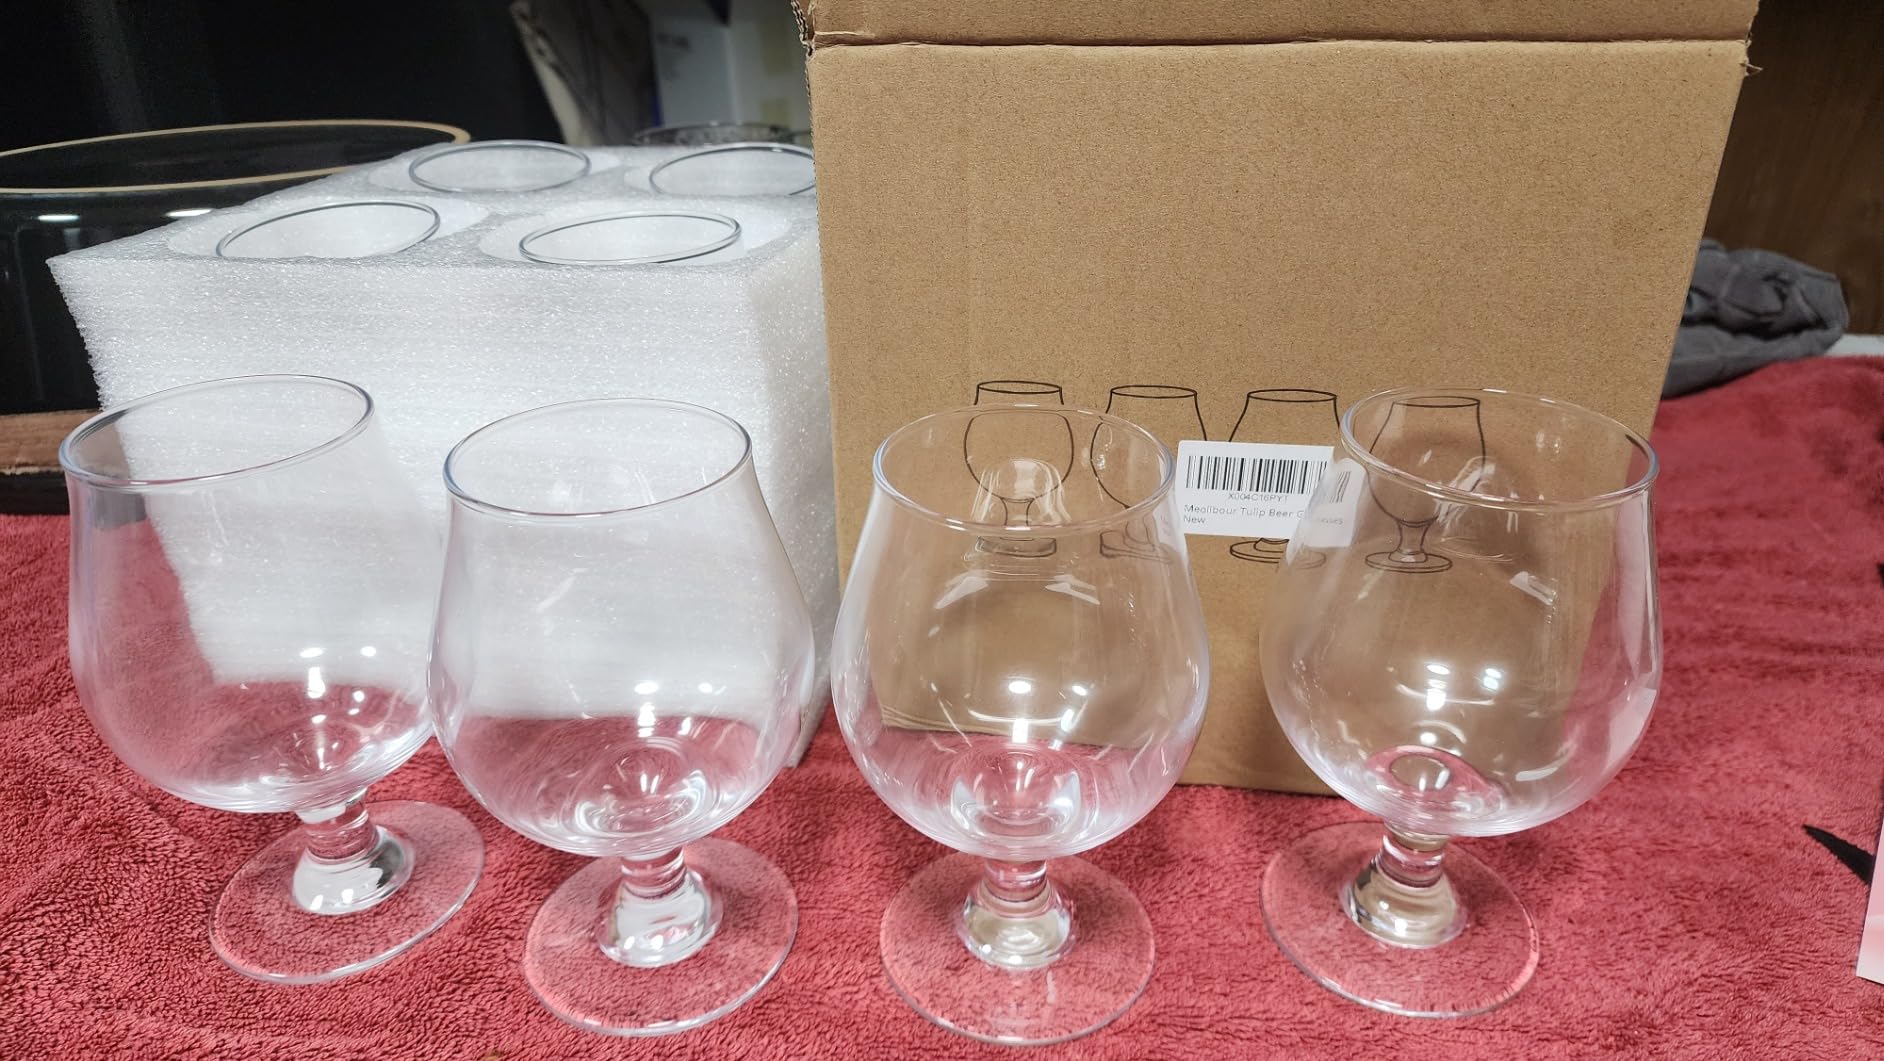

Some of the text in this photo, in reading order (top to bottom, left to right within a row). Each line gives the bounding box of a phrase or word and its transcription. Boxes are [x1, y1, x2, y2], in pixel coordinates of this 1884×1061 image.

[1240, 507, 1266, 519] Tulip
[1269, 508, 1294, 518] Beer
[1183, 514, 1206, 524] New
